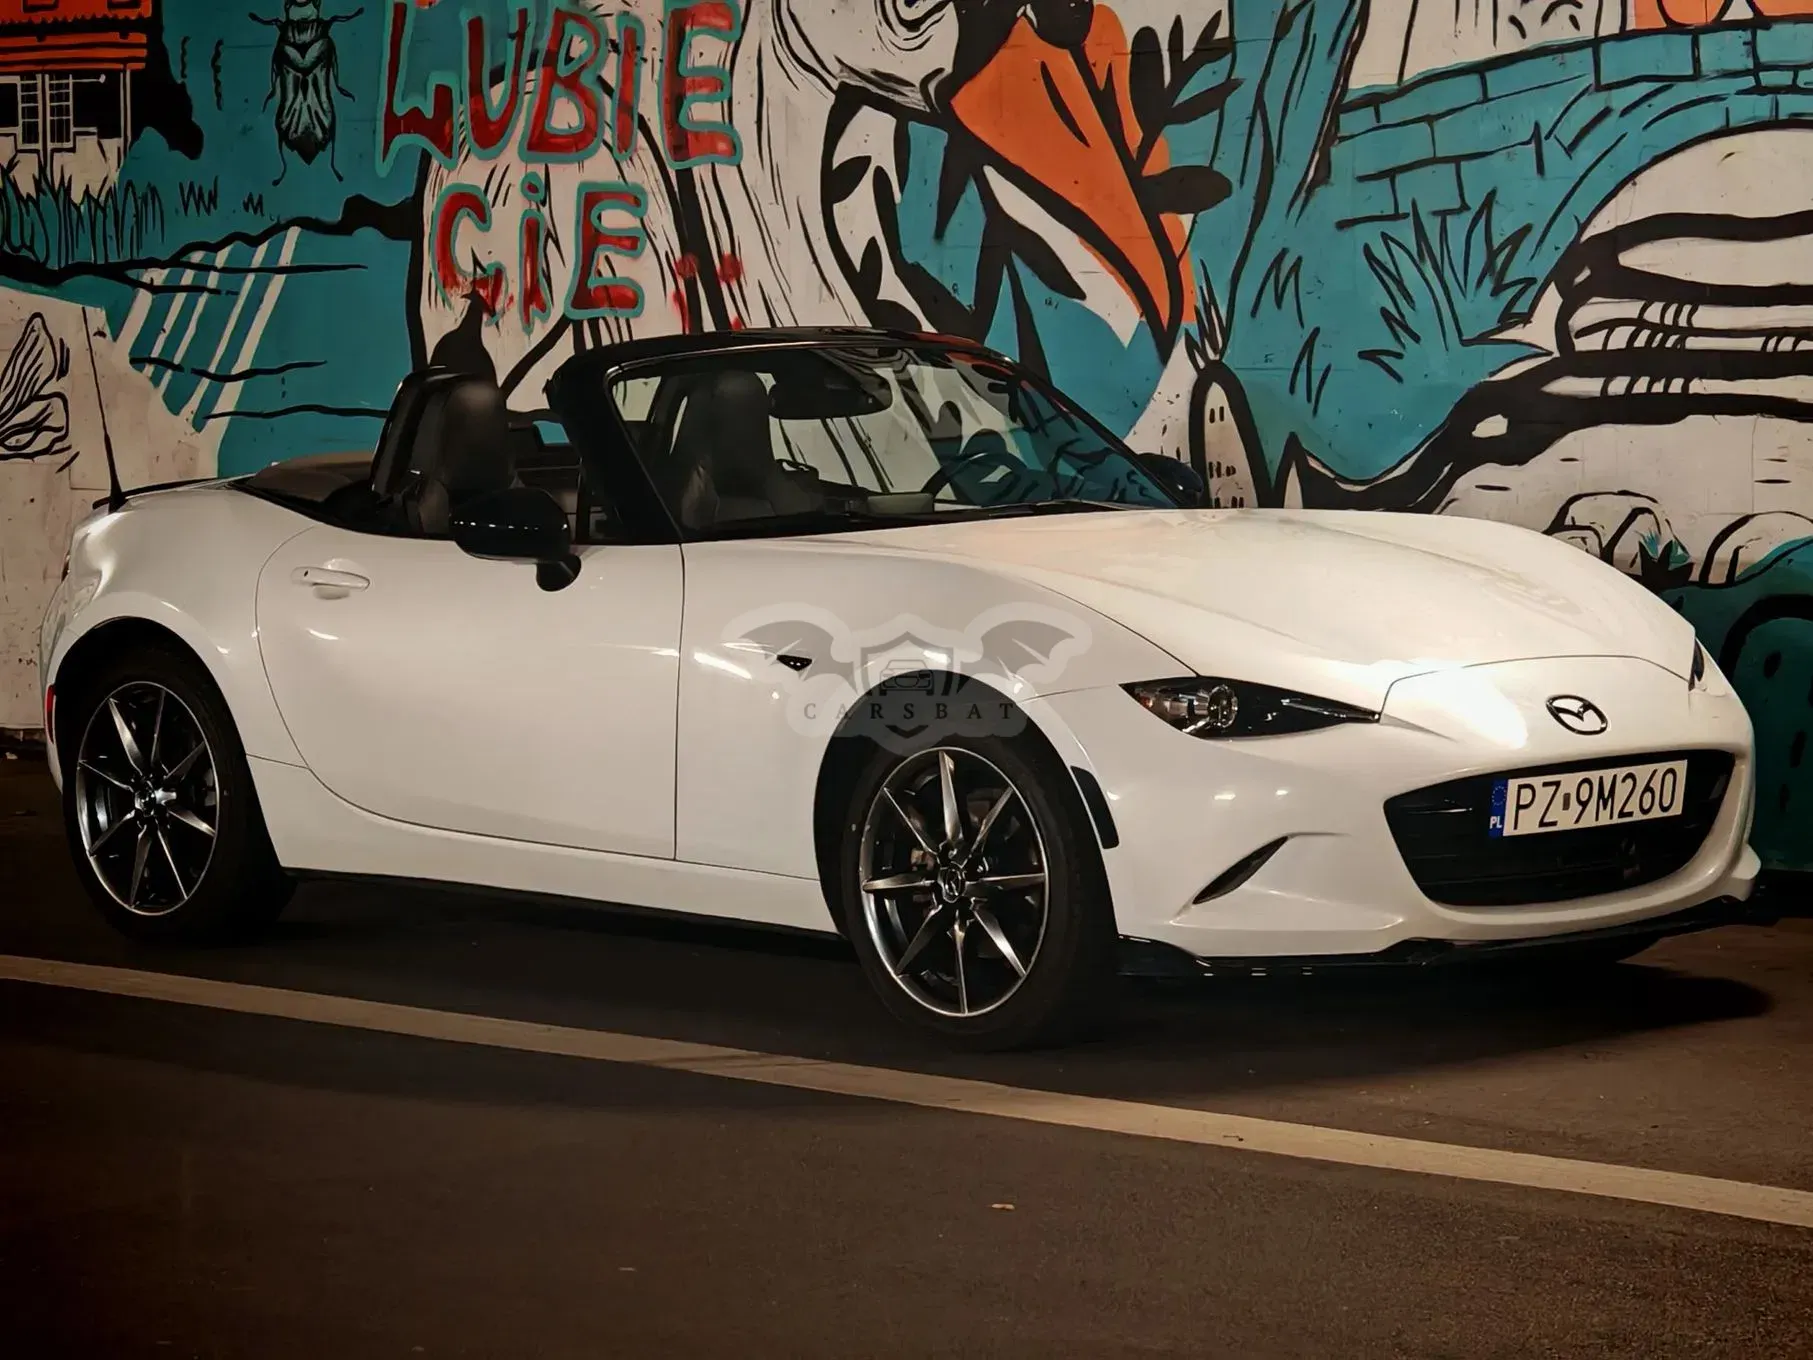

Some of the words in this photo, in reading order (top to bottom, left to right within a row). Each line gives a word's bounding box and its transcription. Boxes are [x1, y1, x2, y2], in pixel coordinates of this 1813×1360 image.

[375, 0, 742, 176] LUBIE
[1489, 815, 1503, 830] PL
[1513, 780, 1562, 830] PZ
[1574, 767, 1678, 825] 9M260
